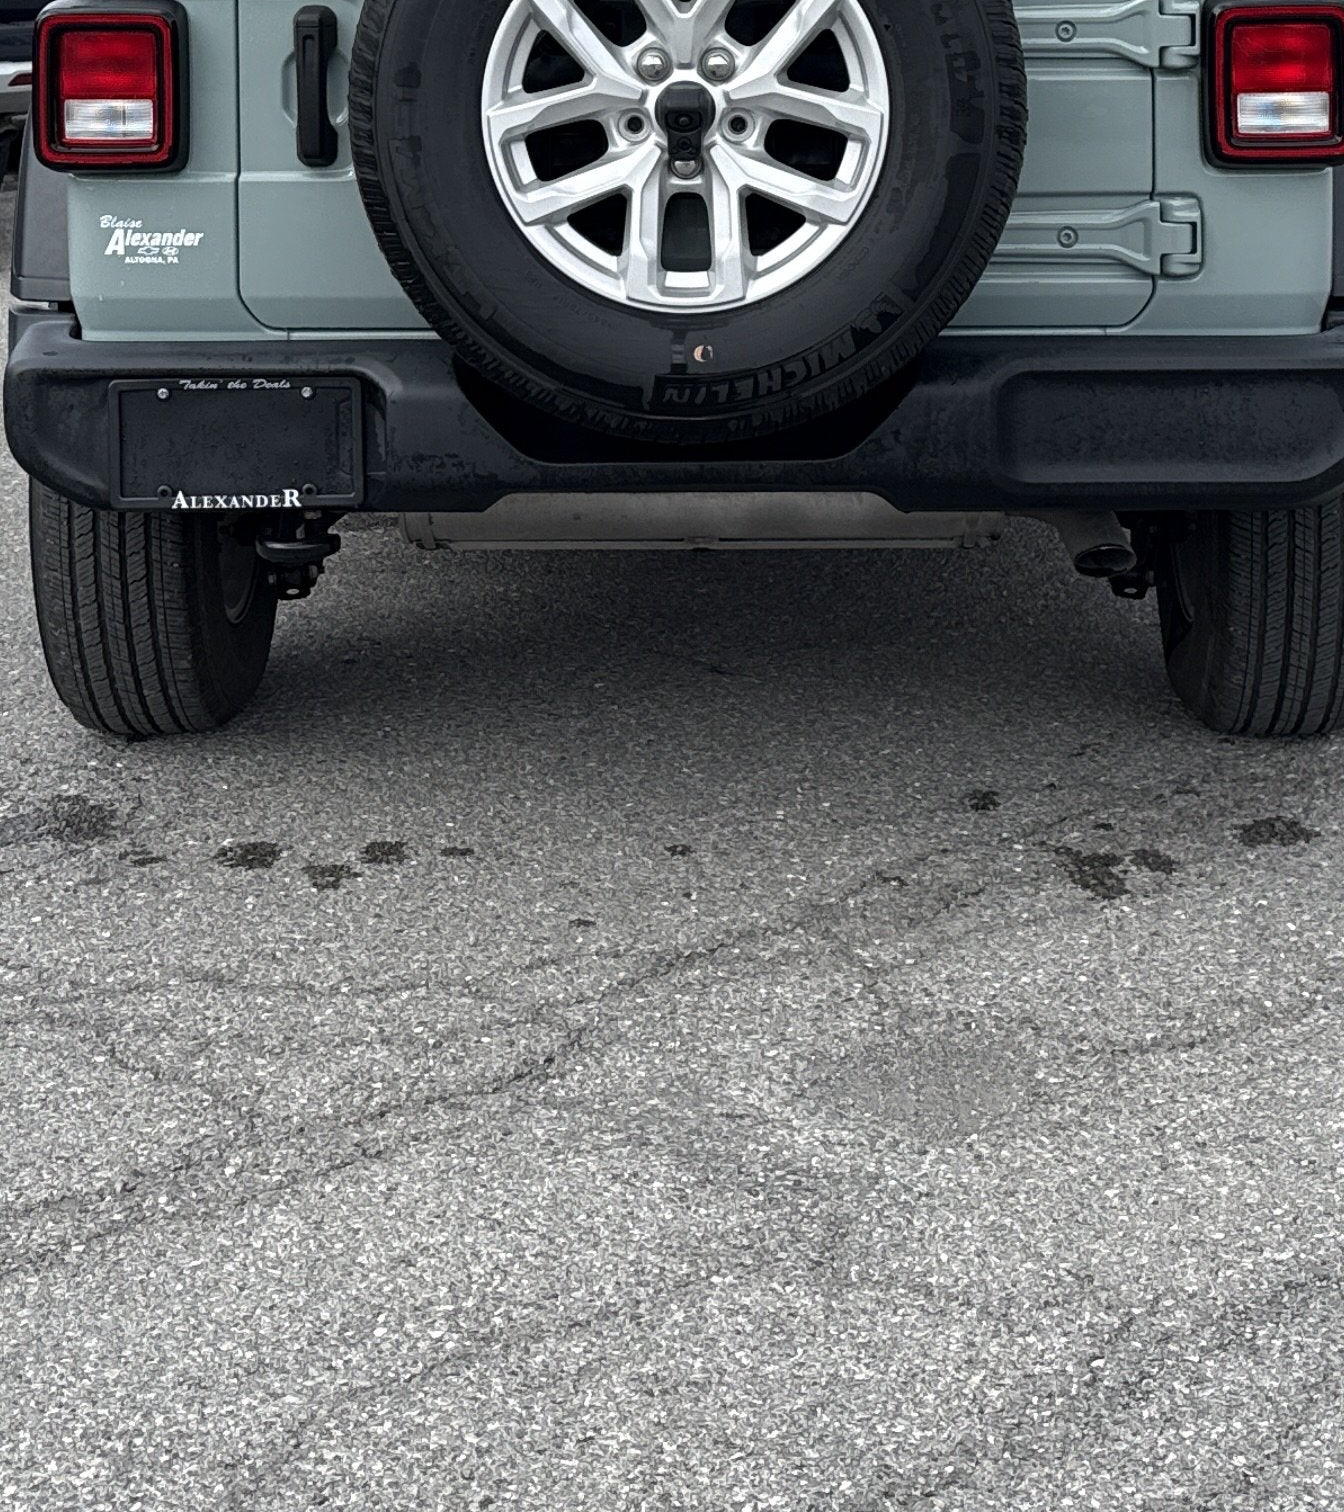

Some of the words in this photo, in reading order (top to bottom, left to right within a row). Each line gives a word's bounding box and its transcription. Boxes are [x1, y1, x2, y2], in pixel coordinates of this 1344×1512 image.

[99, 214, 143, 228] Blaise
[104, 229, 204, 255] Alexander
[167, 256, 179, 264] PA
[662, 324, 859, 405] MICHELIN
[171, 489, 303, 510] ALEXANDER
